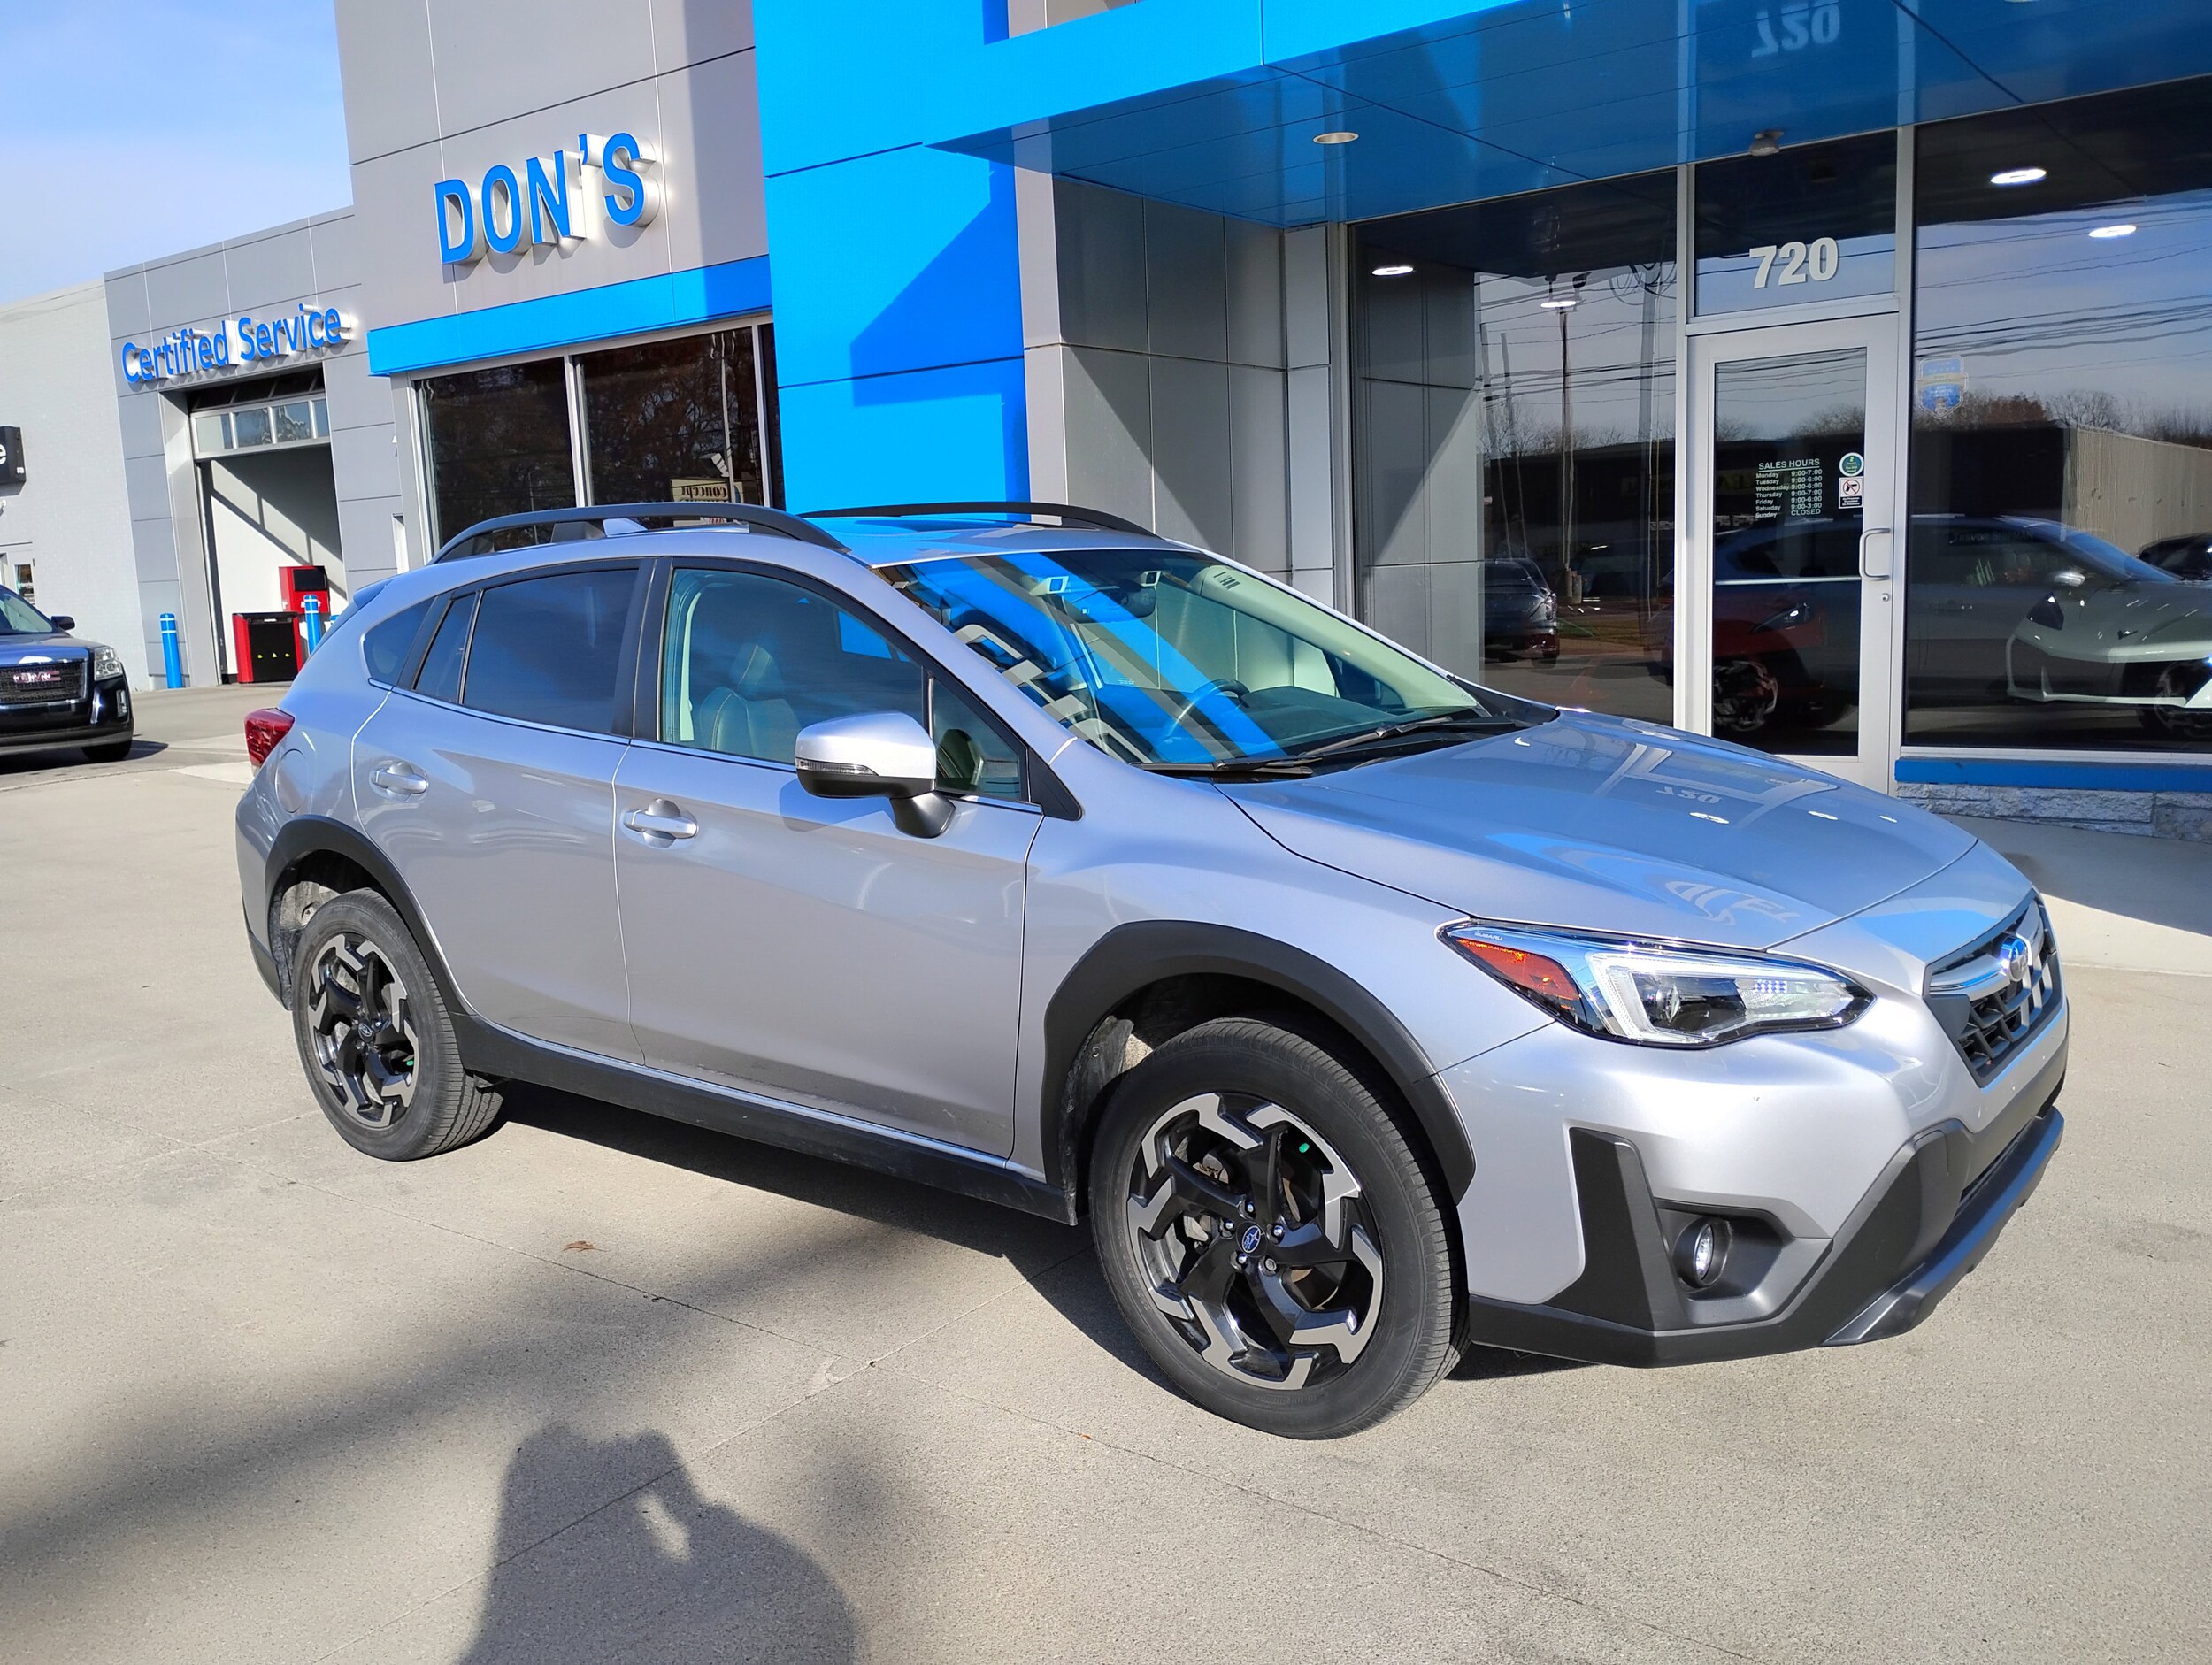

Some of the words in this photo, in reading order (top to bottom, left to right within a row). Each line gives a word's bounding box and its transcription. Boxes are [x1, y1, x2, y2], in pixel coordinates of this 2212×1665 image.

[434, 132, 646, 265] DON'S
[1749, 237, 1839, 289] 720
[121, 319, 230, 384] Certified
[237, 303, 342, 362] Service
[1758, 460, 1787, 470] SALES
[1788, 458, 1821, 467] HOURS
[13, 670, 61, 684] GMC
[1472, 932, 1503, 941] SUBARU
